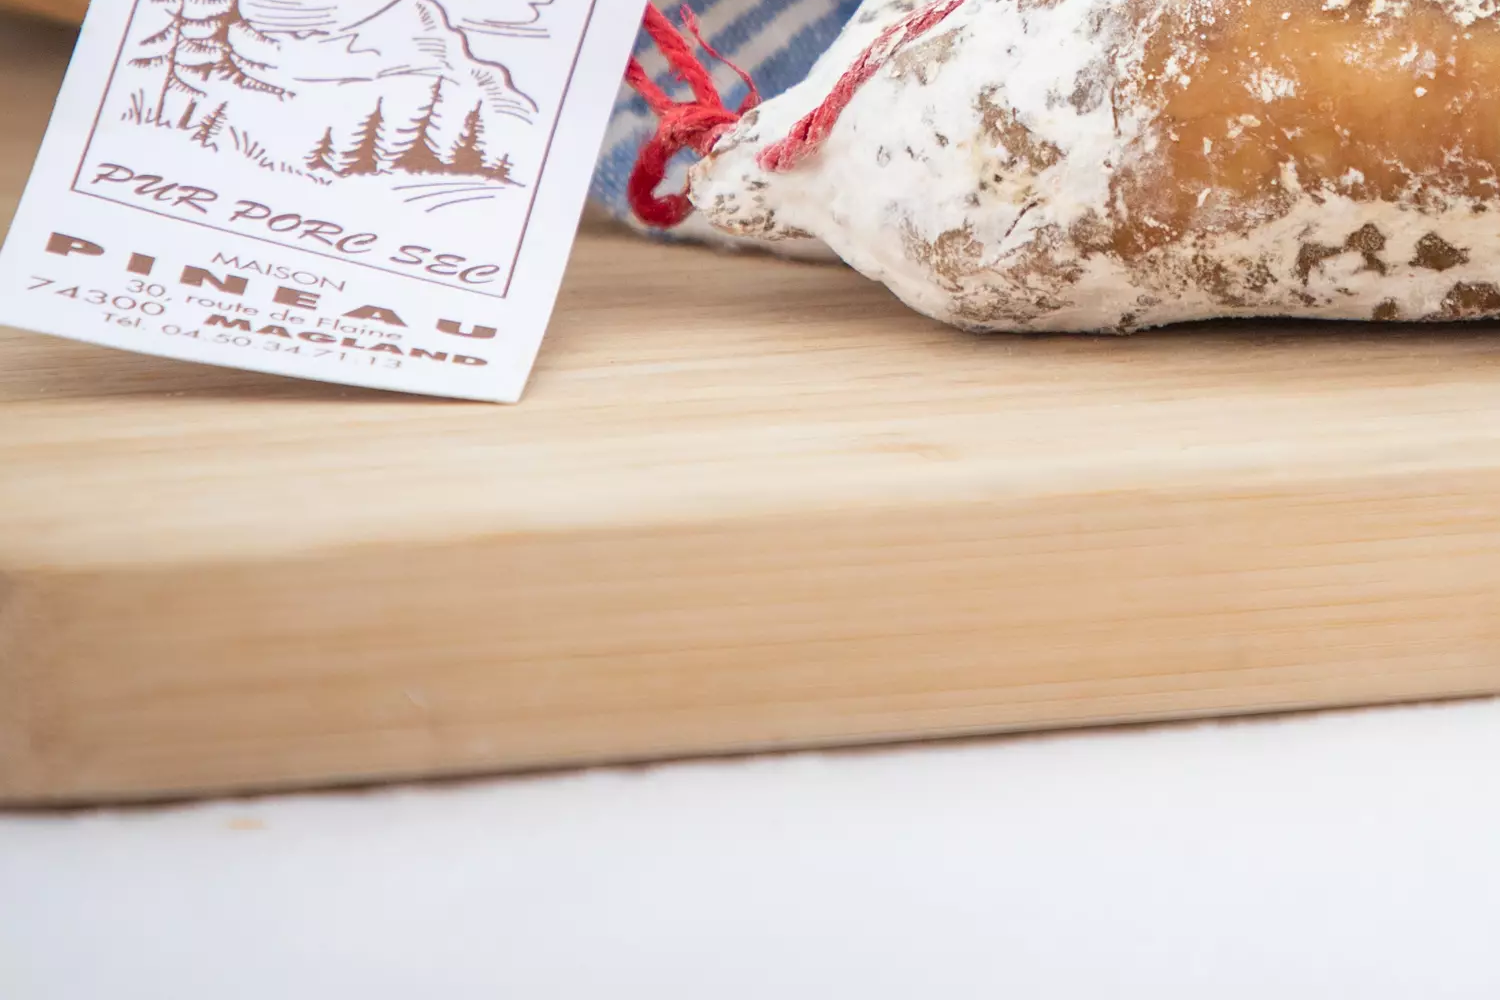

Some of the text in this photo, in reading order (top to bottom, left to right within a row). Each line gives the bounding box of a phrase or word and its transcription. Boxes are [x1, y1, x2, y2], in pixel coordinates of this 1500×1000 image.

[91, 162, 500, 285] PUR PORC SEC
[45, 231, 498, 340] PINEAU
[126, 278, 403, 341] 30, route de Flaine
[211, 251, 347, 293] MAISON
[27, 275, 489, 367] 74300 MAGLAND
